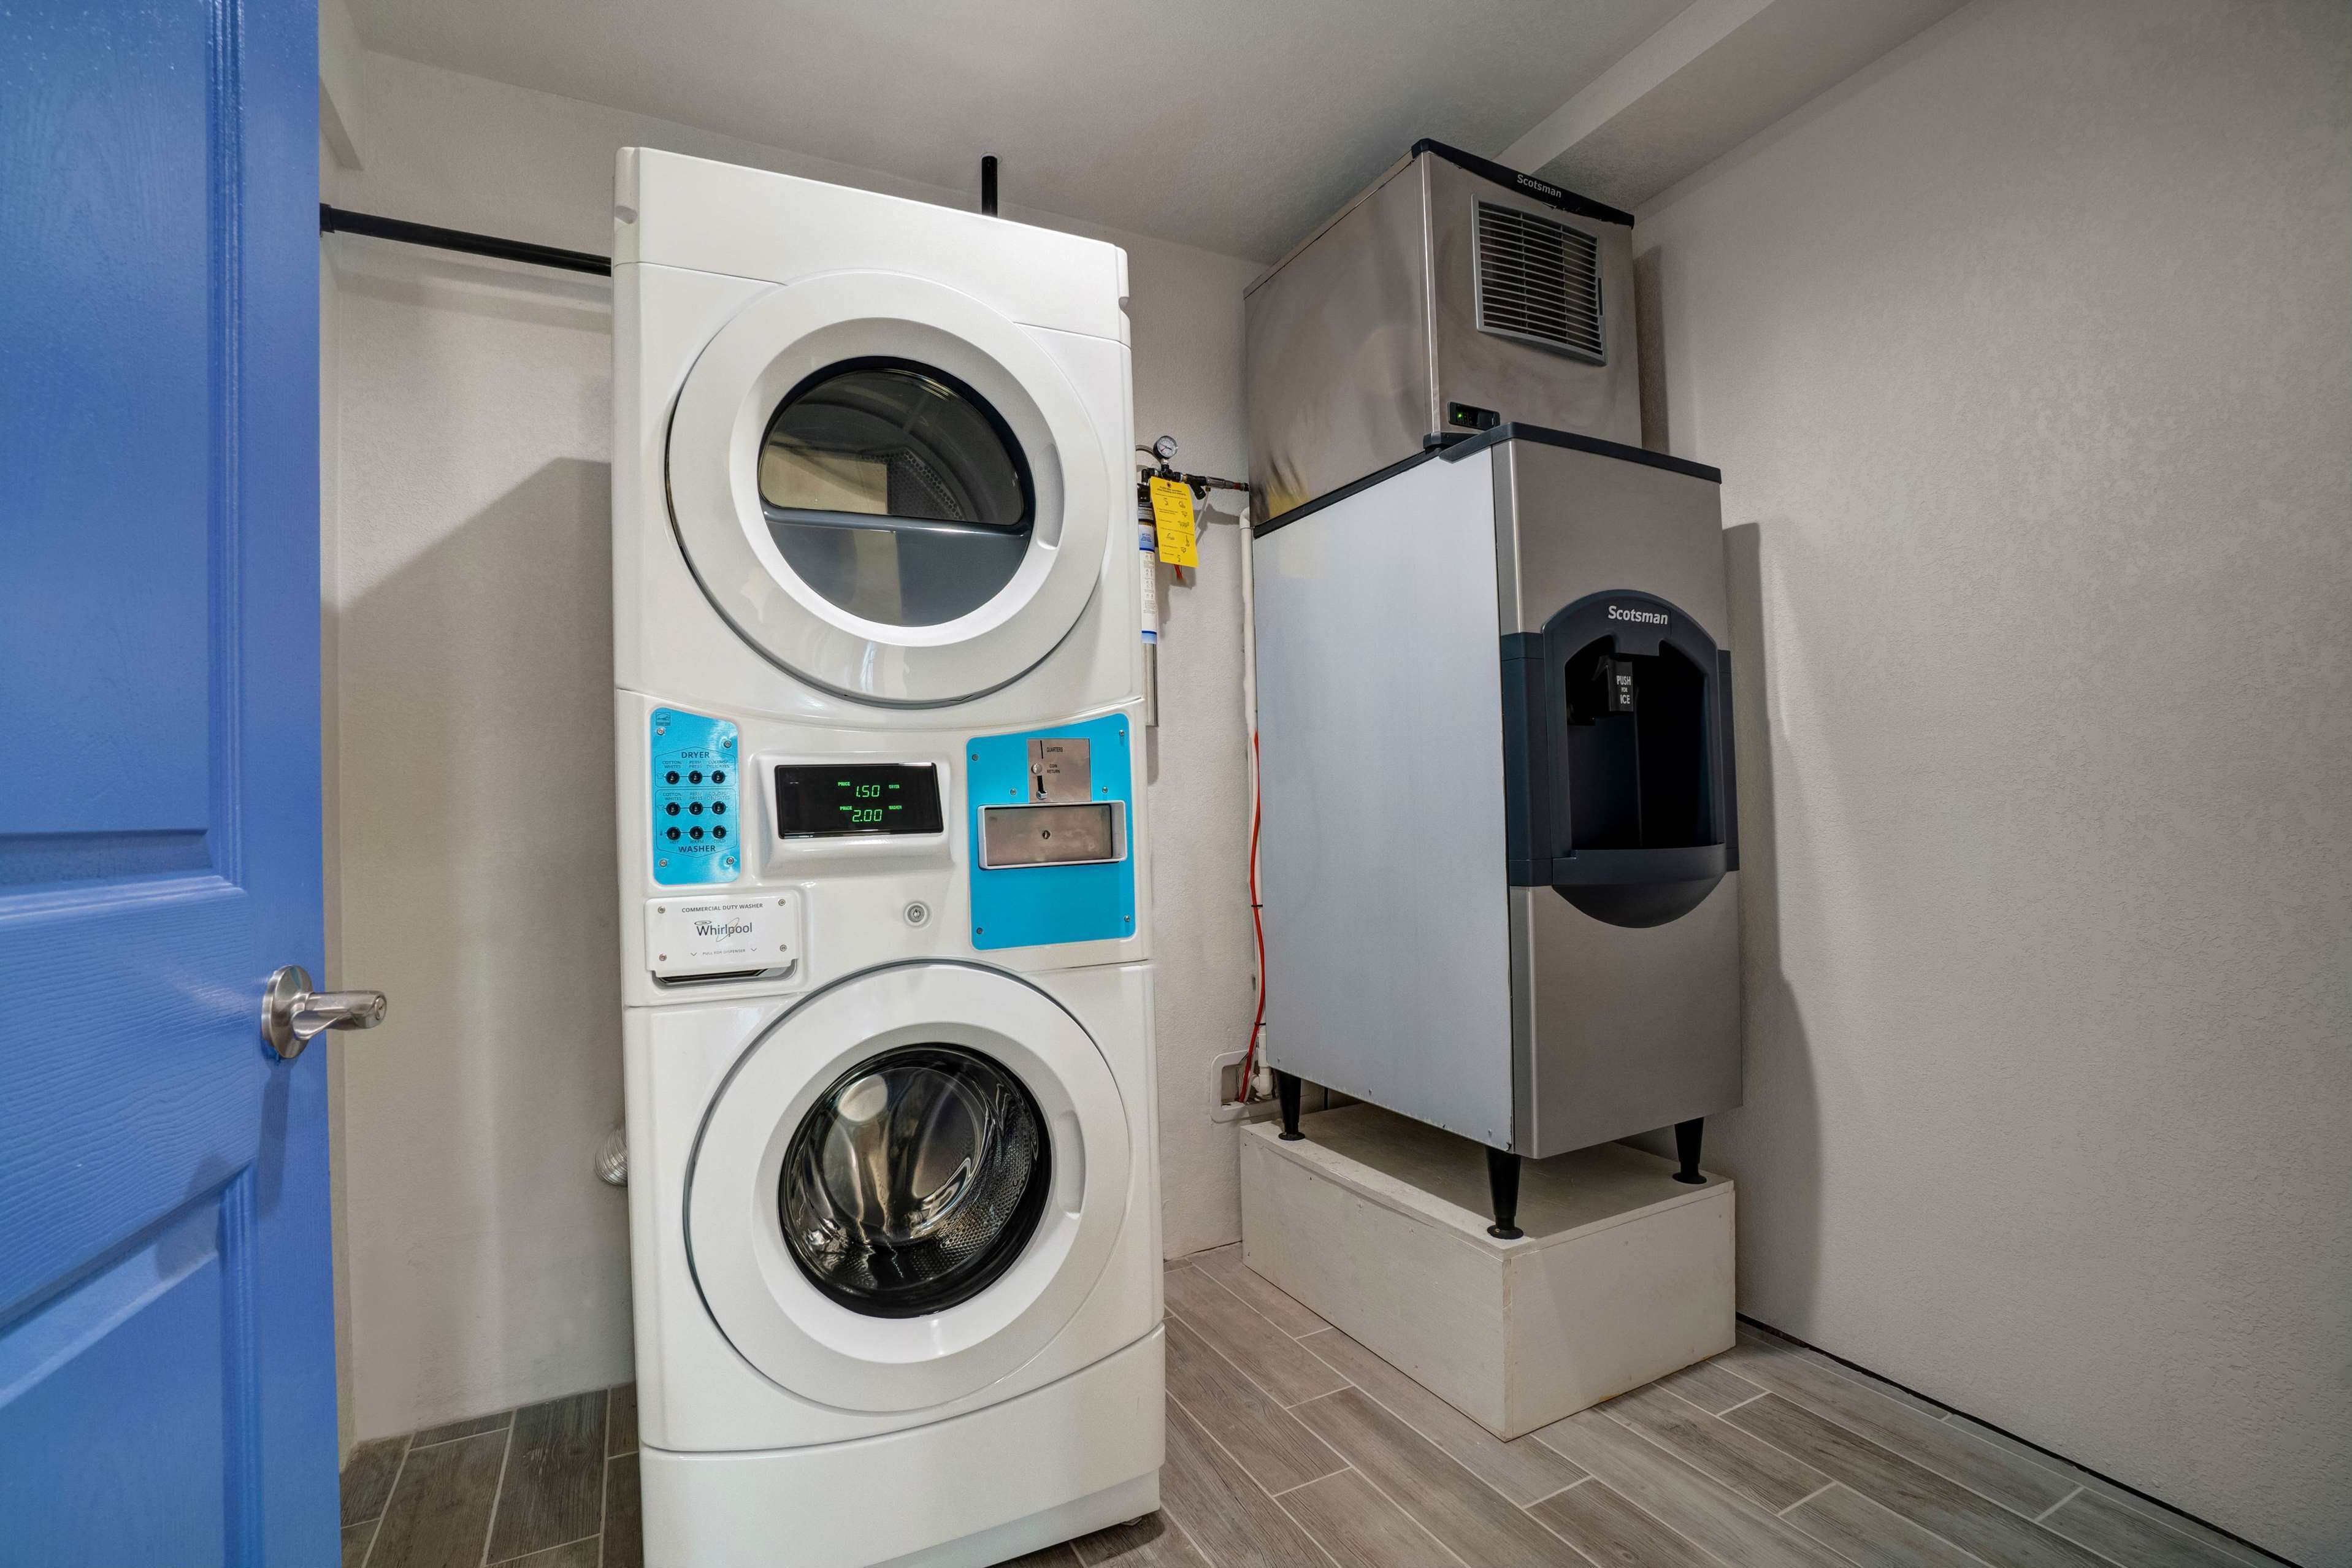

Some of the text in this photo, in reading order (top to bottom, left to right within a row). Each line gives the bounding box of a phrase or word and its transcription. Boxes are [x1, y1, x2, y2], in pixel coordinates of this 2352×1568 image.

[1517, 174, 1561, 198] Scotsman
[1607, 605, 1668, 625] Scotsman
[1616, 675, 1631, 686] PUSH
[1620, 694, 1631, 704] ICE
[856, 785, 880, 797] 1.50
[852, 809, 883, 822] 2.00
[696, 922, 753, 938] Whirlpool
